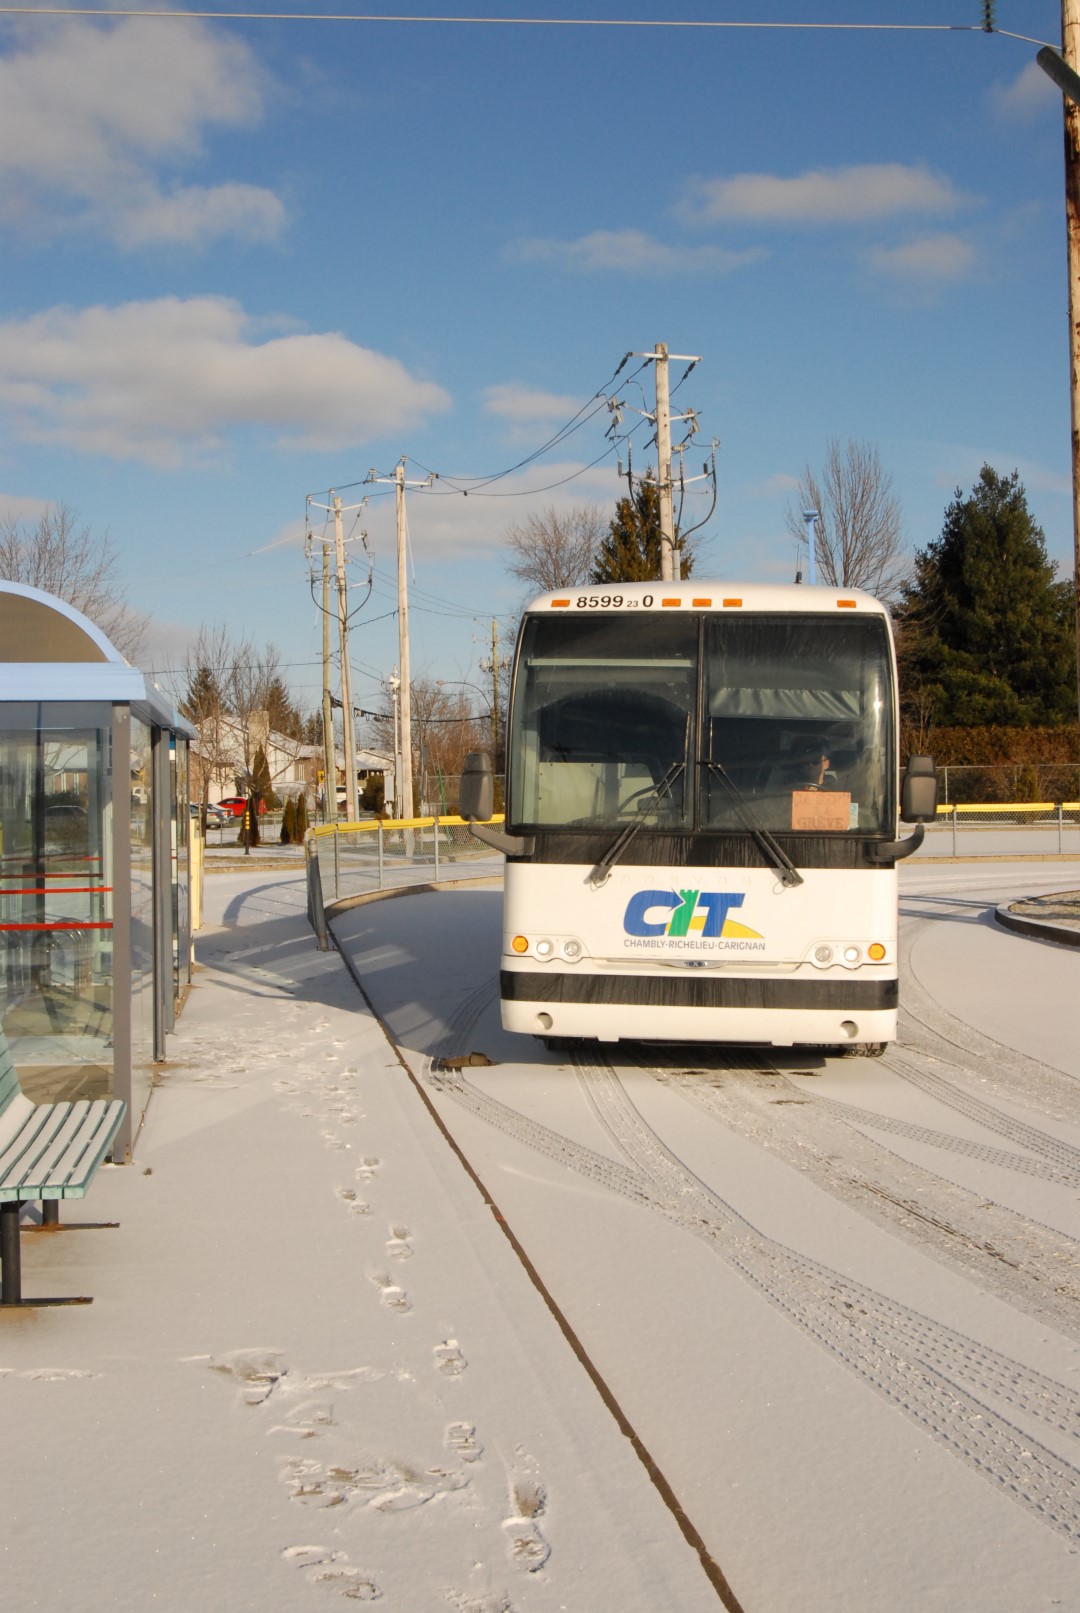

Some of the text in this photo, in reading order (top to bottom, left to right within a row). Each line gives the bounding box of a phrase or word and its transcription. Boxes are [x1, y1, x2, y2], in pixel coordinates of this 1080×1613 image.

[576, 595, 654, 608] 8599 23 0
[623, 887, 746, 938] CIT
